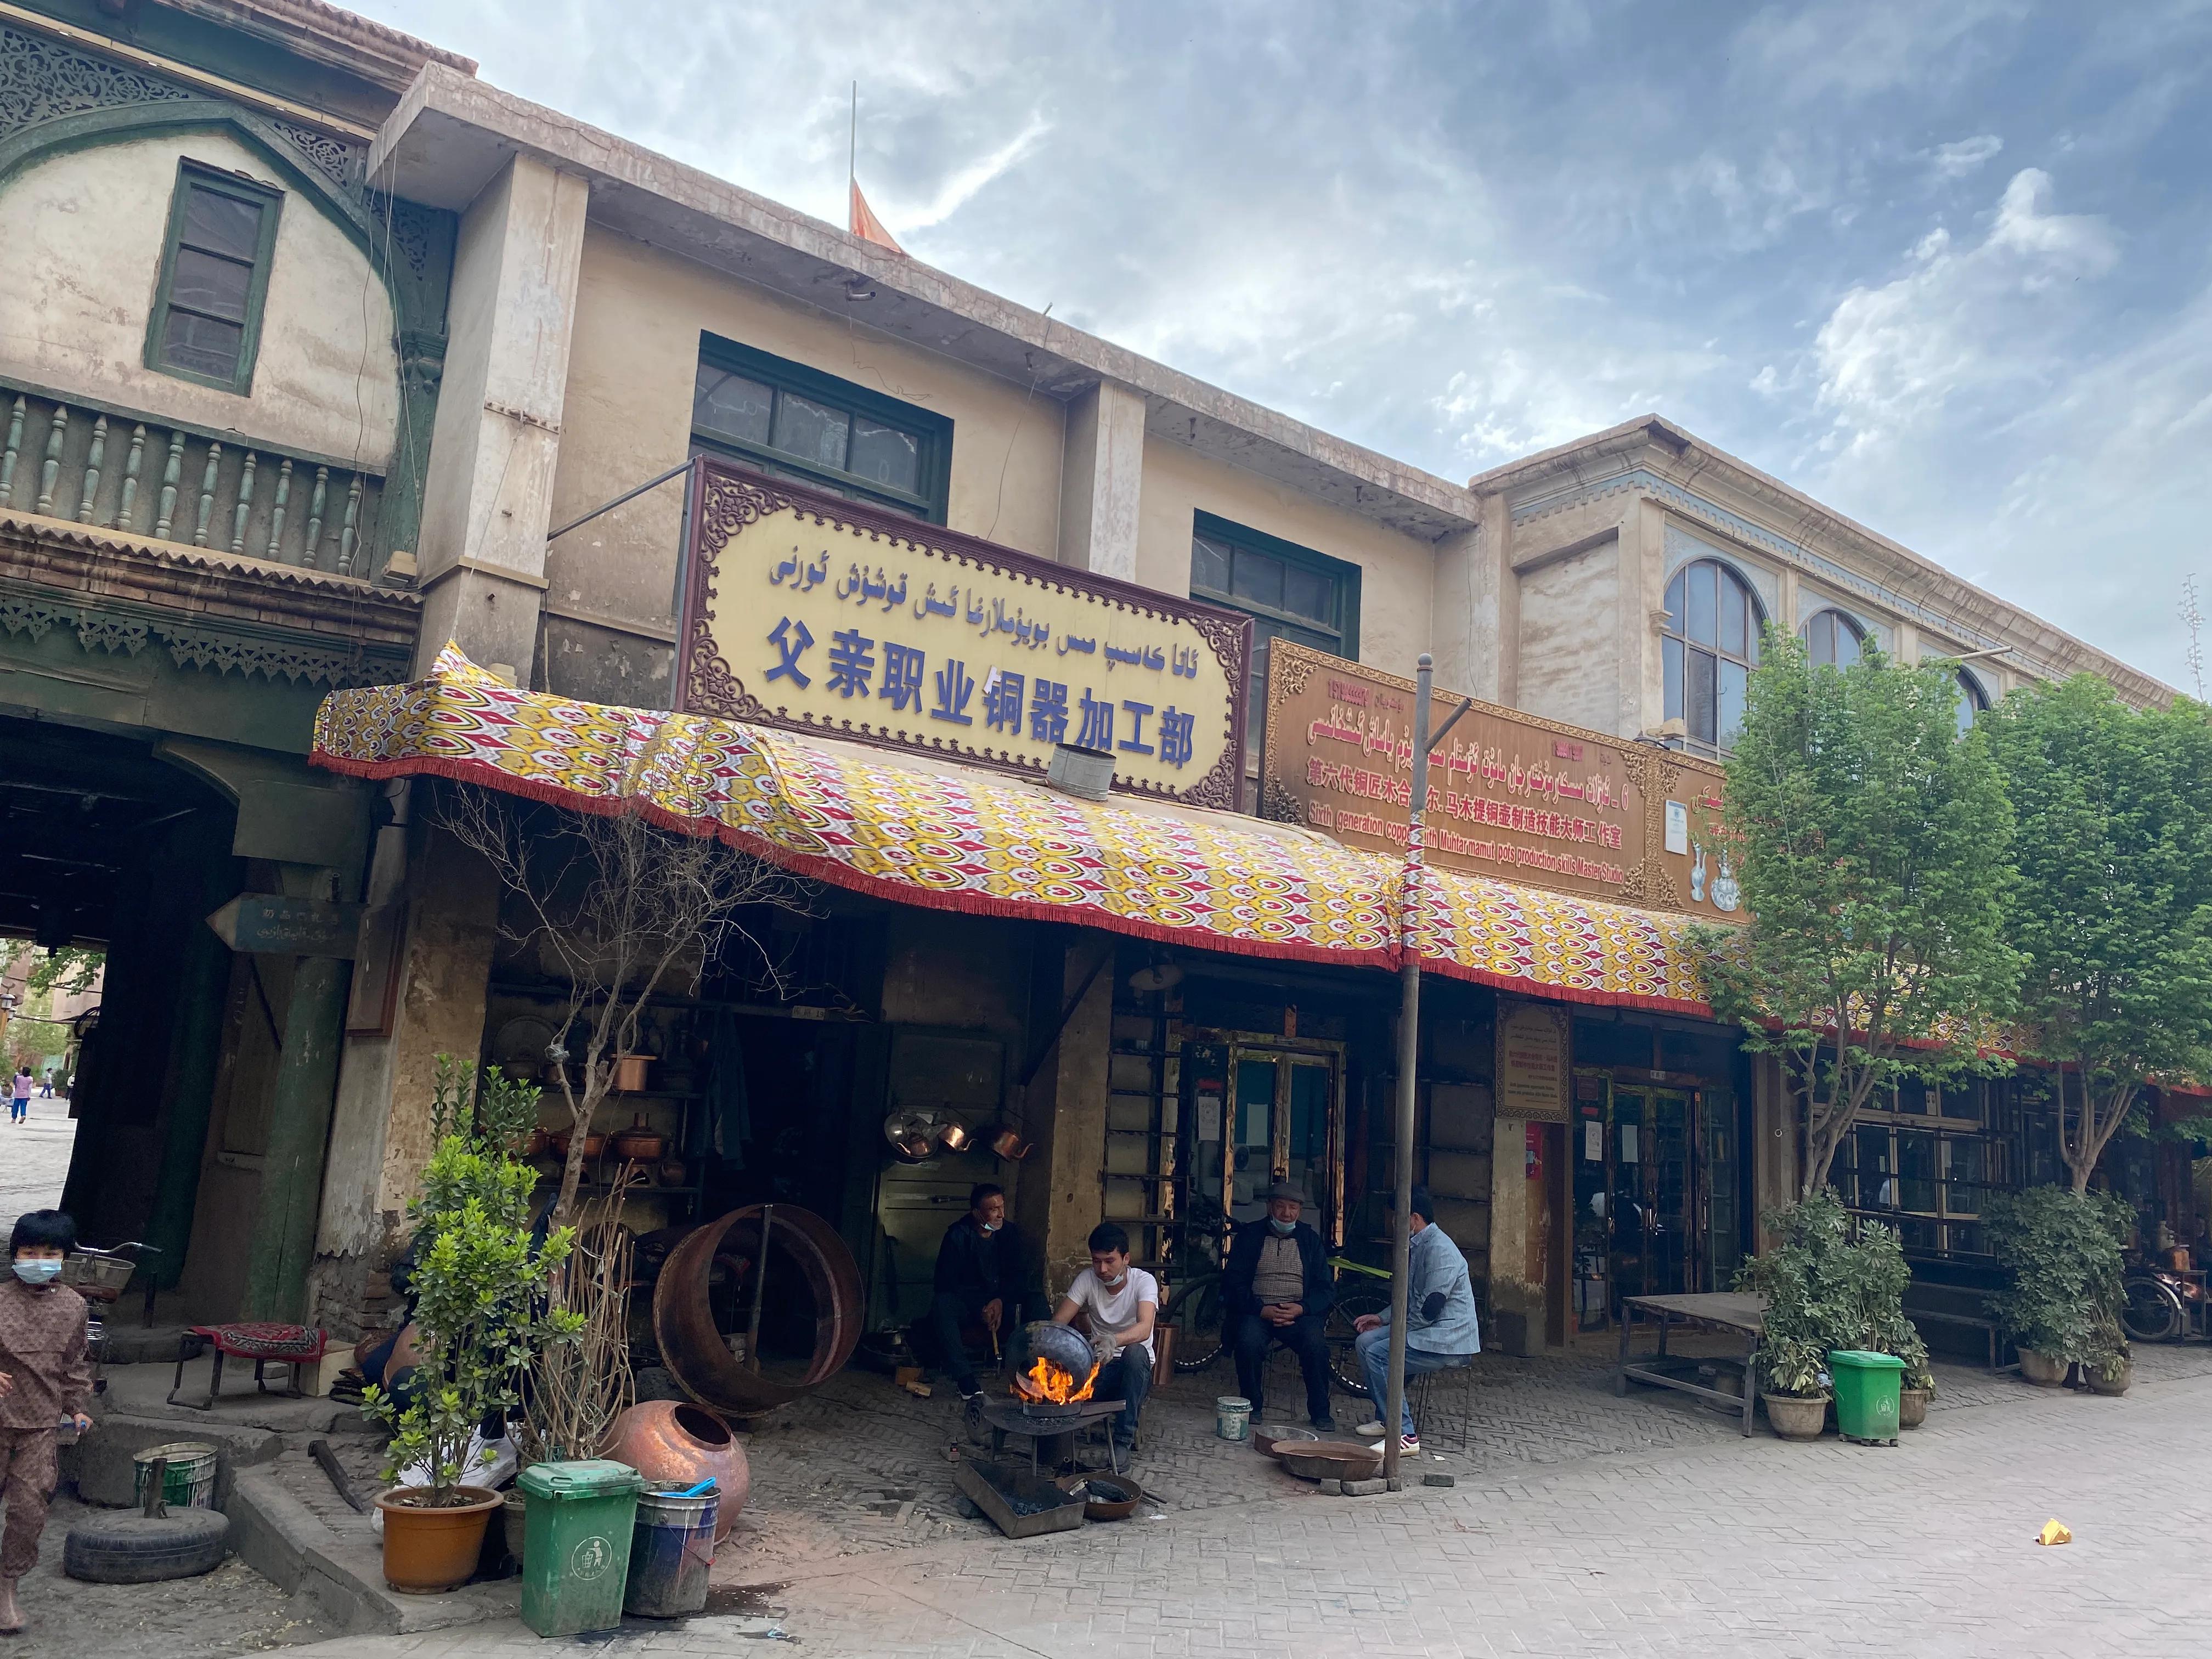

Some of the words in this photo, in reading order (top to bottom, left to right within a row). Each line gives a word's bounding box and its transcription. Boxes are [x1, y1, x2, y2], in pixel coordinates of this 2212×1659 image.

[769, 545, 830, 592] ئورنى
[837, 562, 909, 613] قوشۇش
[913, 582, 960, 619] ئىش
[1057, 633, 1096, 656] مىس
[764, 615, 1195, 769] 父亲职业铜器加工部
[1308, 799, 1333, 827] Sixth
[1336, 810, 1384, 837] generation
[1497, 842, 1516, 865] pots
[1516, 846, 1557, 873] production
[1556, 854, 1577, 876] skills
